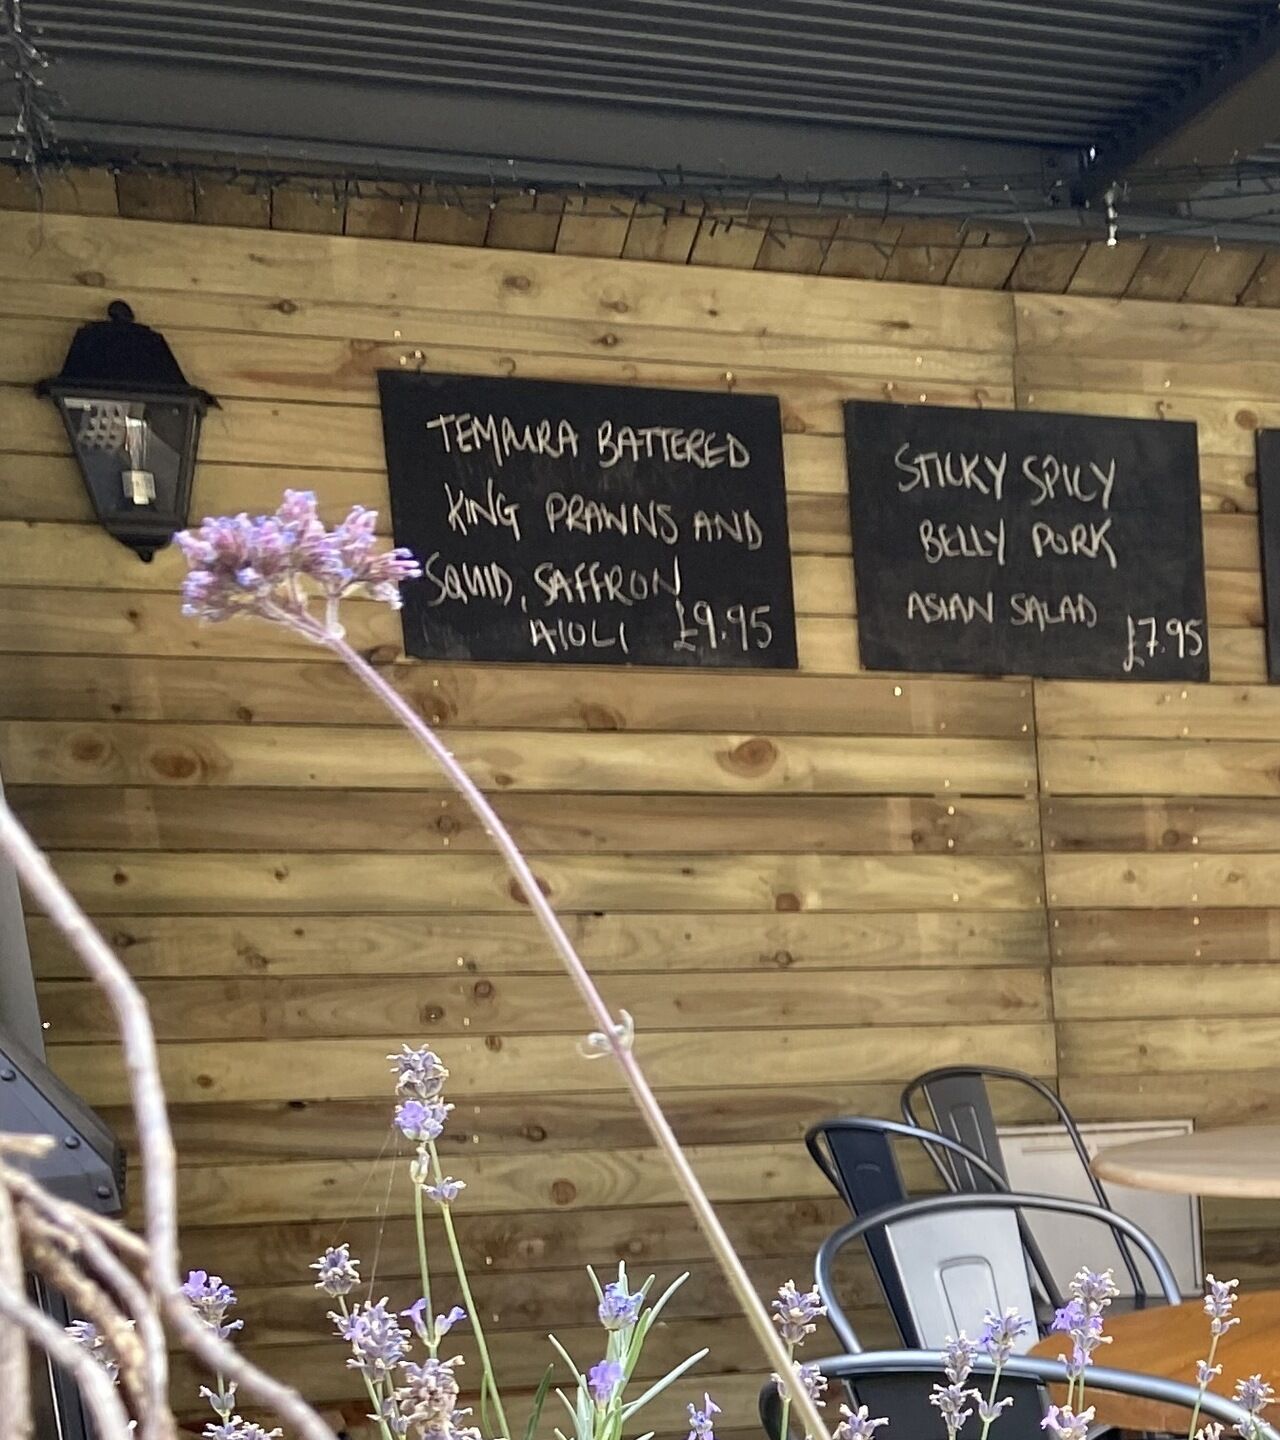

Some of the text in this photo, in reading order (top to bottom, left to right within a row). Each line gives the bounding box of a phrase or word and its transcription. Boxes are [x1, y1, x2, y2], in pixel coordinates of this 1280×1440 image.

[426, 413, 750, 469] TEMPURA BATTERED
[895, 443, 1117, 511] STICKY SPICY
[444, 478, 763, 551] KING PRAWNS AND
[919, 517, 1118, 569] BELLY PORK
[425, 551, 682, 613] SQUID, SAFFRON
[530, 600, 773, 655] AIOLI £9.95
[907, 591, 1098, 632] ASIAN SALAD
[1122, 614, 1203, 673] £7.95
